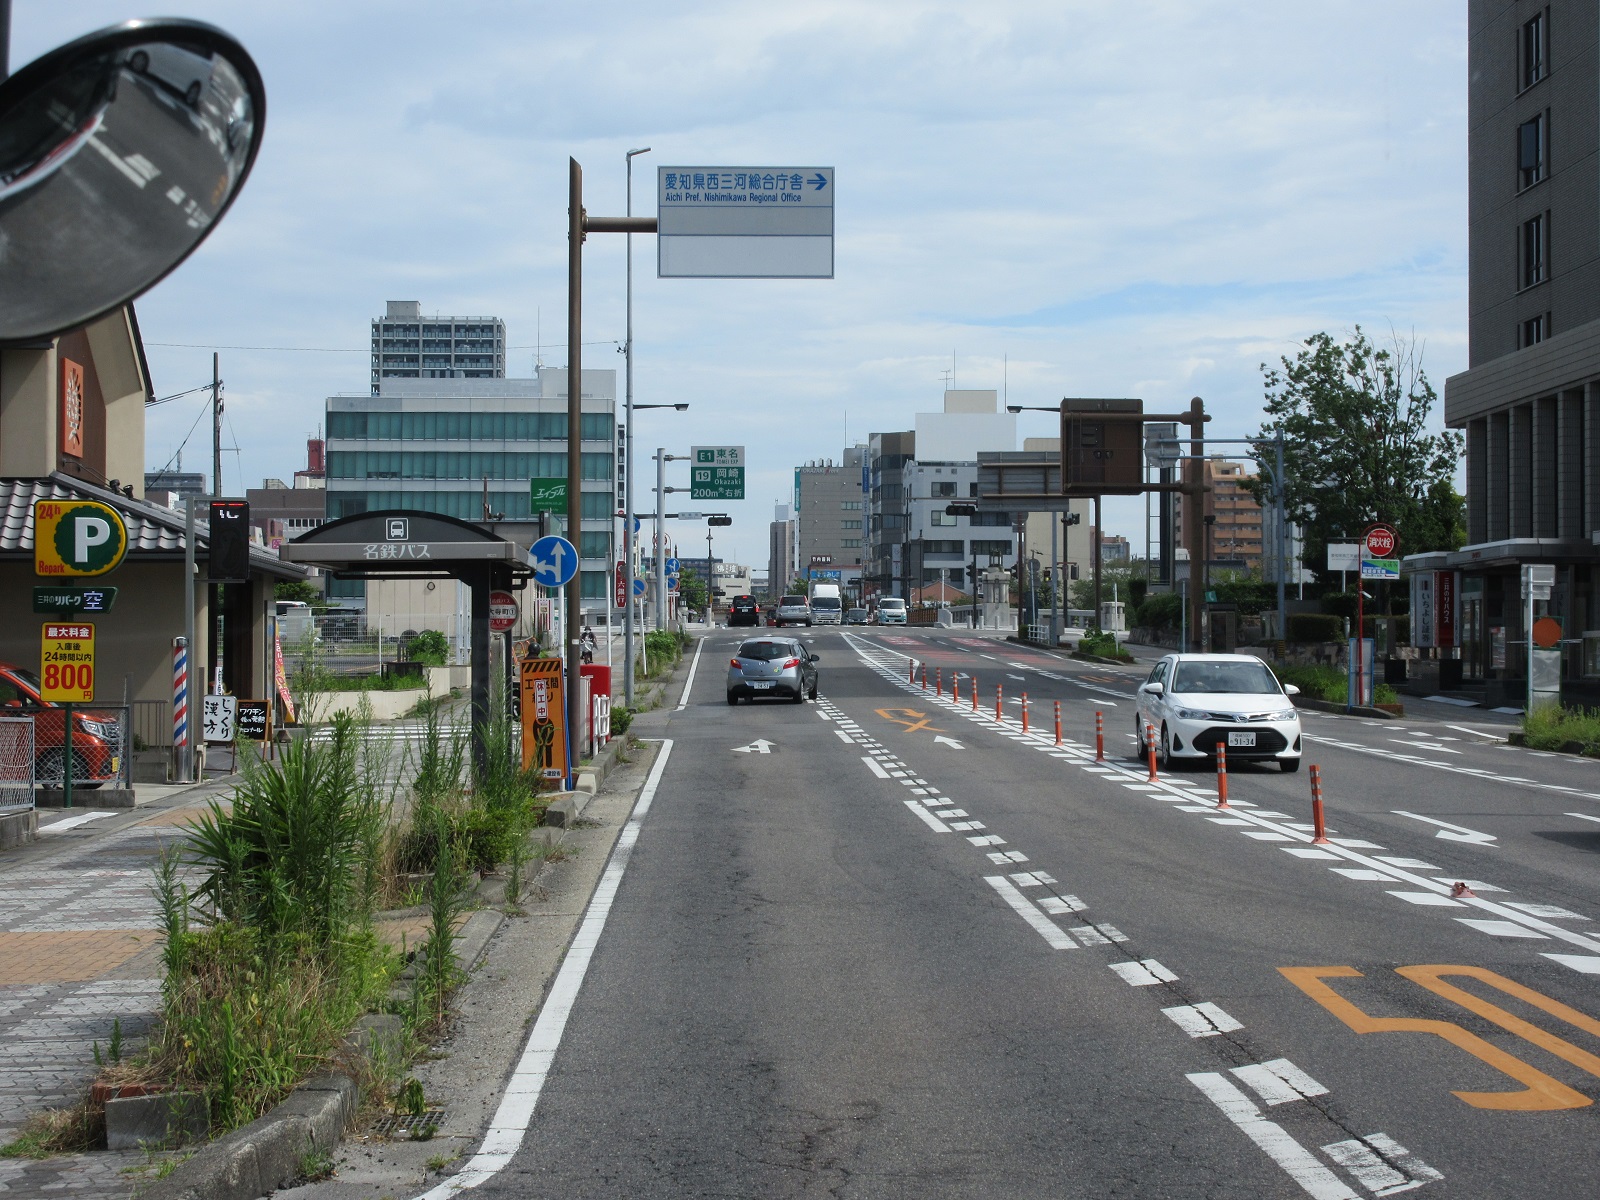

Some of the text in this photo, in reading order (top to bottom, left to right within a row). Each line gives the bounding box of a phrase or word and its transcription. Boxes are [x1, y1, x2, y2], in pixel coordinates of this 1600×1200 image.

[665, 173, 803, 190] 愛知県西三河総合庁舎
[665, 192, 801, 204] Aichi Pref. Nishimikawa Regional Office
[700, 452, 712, 461] E1
[716, 448, 738, 458] 東名
[697, 472, 709, 480] 19
[716, 468, 739, 478] 岡崎
[532, 485, 566, 499] エイブル
[74, 516, 111, 563] P
[1368, 537, 1392, 548] 消火栓
[363, 543, 431, 560] 名鉄バス
[38, 560, 65, 574] Repark
[617, 579, 625, 603] 六銀行
[37, 590, 104, 610] 三井のリパーク 空
[1421, 593, 1430, 642] いちよし証券
[47, 627, 90, 638] 最大料金
[56, 642, 81, 651] 入庫後
[44, 651, 92, 662] 24時間以内
[44, 663, 93, 690] 800
[525, 677, 559, 690] 工区間
[83, 690, 92, 700] 円
[536, 682, 546, 715] 休工中
[203, 700, 219, 734] 漢方
[220, 698, 232, 739] じっくり
[239, 708, 265, 716] ワクチン
[1234, 737, 1254, 745] 91-34
